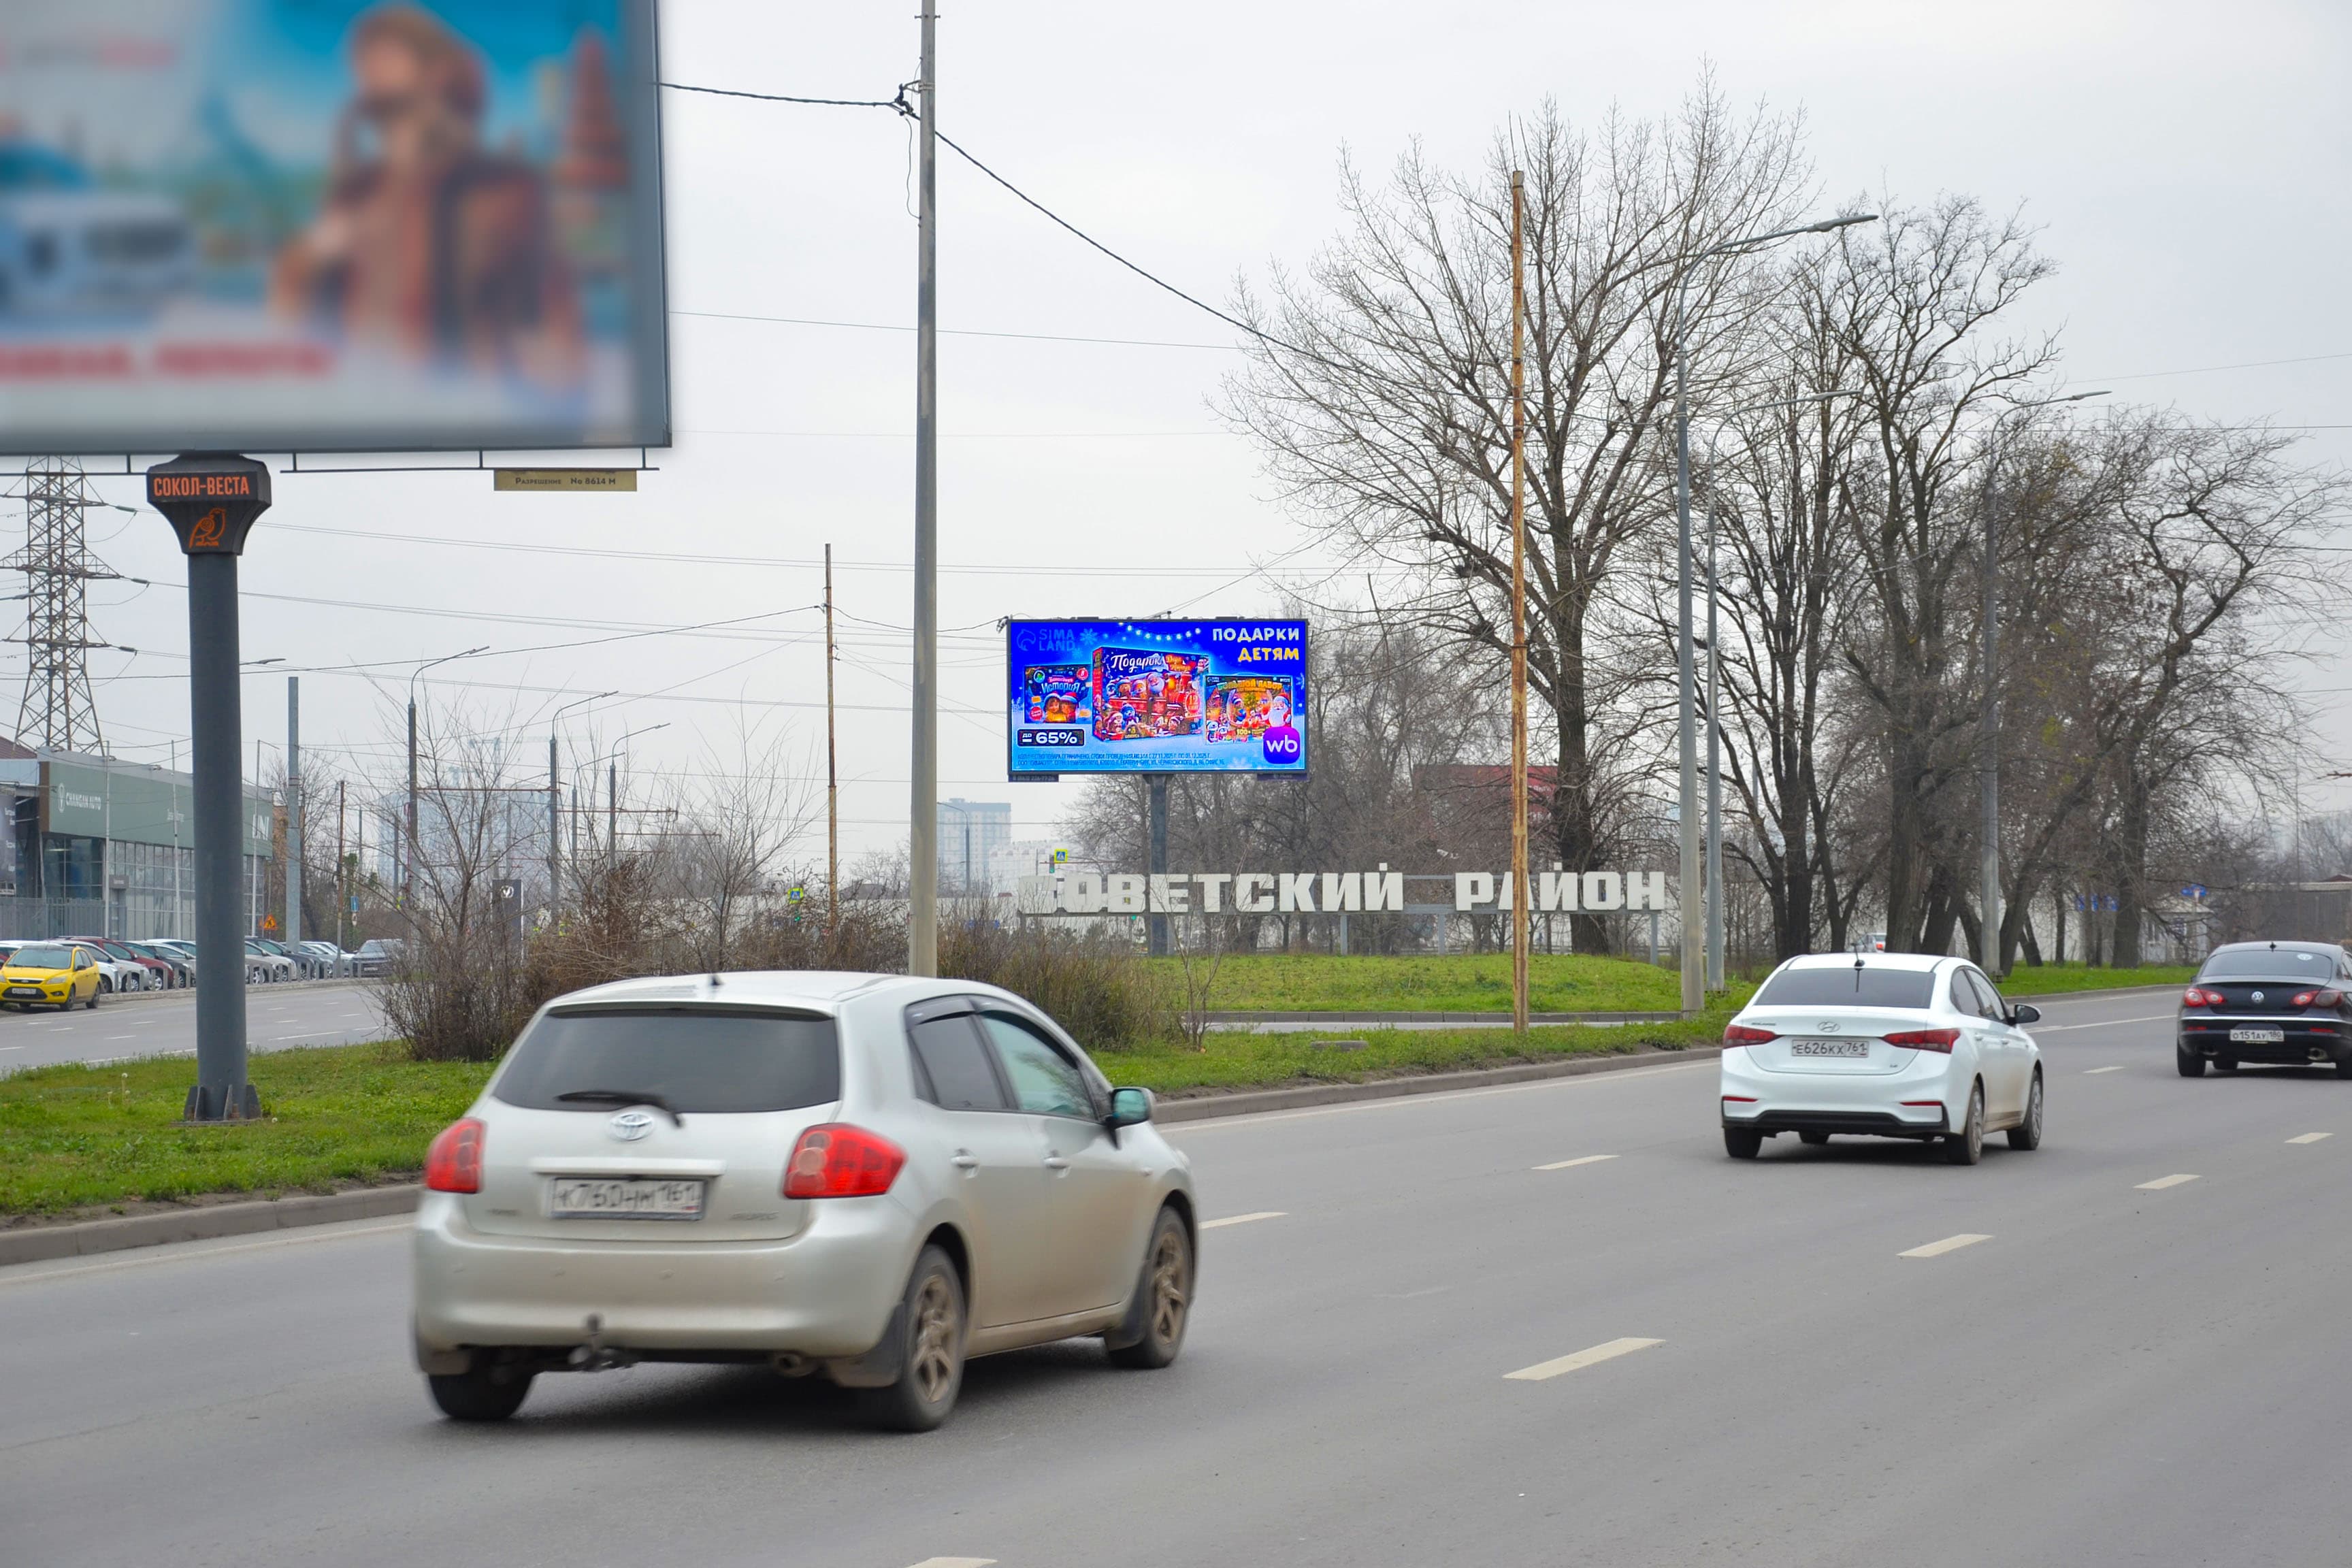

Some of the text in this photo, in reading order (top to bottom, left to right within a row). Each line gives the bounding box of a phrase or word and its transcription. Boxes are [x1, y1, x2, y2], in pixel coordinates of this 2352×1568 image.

[153, 476, 250, 496] СОКОЛ-ВЕСТА
[1039, 628, 1075, 640] SIMA
[1212, 627, 1299, 642] ПОДАРКИ
[1238, 647, 1299, 662] ДЕТЯМ
[1267, 734, 1298, 753] wb
[1019, 862, 1665, 913] СОВЕТСКИЙ РАЙОН
